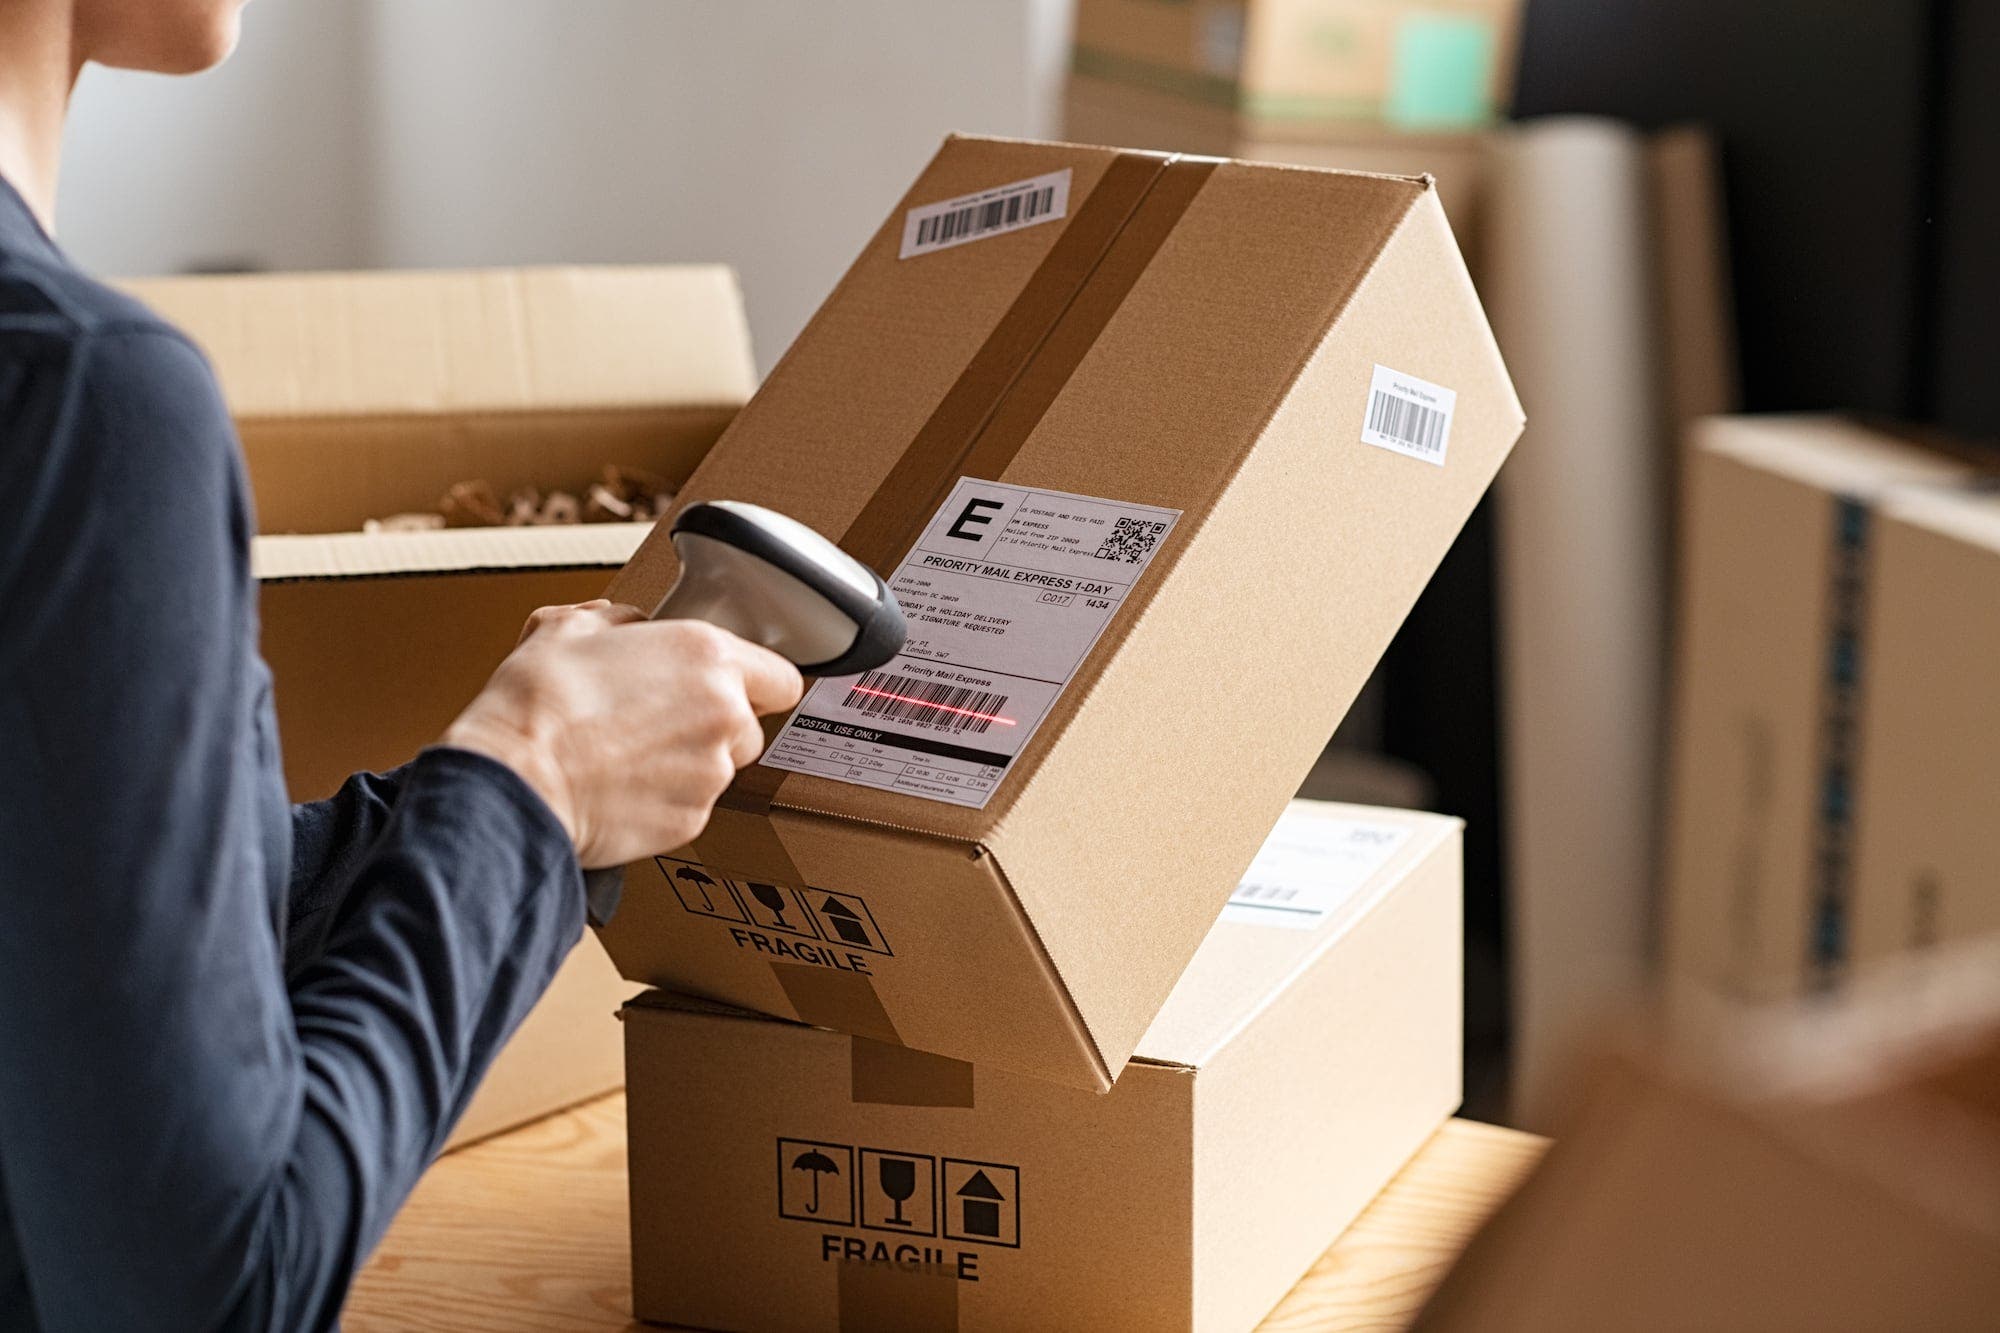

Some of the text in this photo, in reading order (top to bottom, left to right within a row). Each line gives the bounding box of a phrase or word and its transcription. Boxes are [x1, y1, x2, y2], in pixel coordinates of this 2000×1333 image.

[946, 497, 1004, 542] E
[1030, 508, 1056, 518] POSTAGE
[1072, 515, 1087, 523] FEES
[1022, 520, 1050, 530] EXPRESS
[1005, 528, 1028, 536] Mailed
[1030, 531, 1044, 539] from
[1020, 540, 1049, 550] Priority
[1051, 545, 1066, 553] Mail
[923, 555, 1113, 596] PRIORITY MAIL EXPRESS 1-DAY
[892, 586, 928, 597] Washington
[1042, 592, 1070, 605] C017
[1085, 598, 1111, 610] 1434
[897, 600, 924, 610] SUNDAY
[939, 608, 972, 619] HOLIDAY
[974, 614, 1012, 626] DELIVERY
[920, 614, 961, 628] SIGNATURE
[963, 622, 1005, 636] REQUESTED
[906, 645, 932, 656] London
[902, 663, 992, 687] Priority Mail Express
[795, 717, 882, 741] POSTAL USE ONLY
[781, 742, 791, 751] Day
[797, 745, 817, 755] Delivery
[844, 741, 855, 750] Day
[840, 754, 855, 762] 1-Day
[868, 759, 884, 768] 2-Day
[729, 927, 873, 976] FRAGILE
[822, 1234, 980, 1282] FRAGILE
